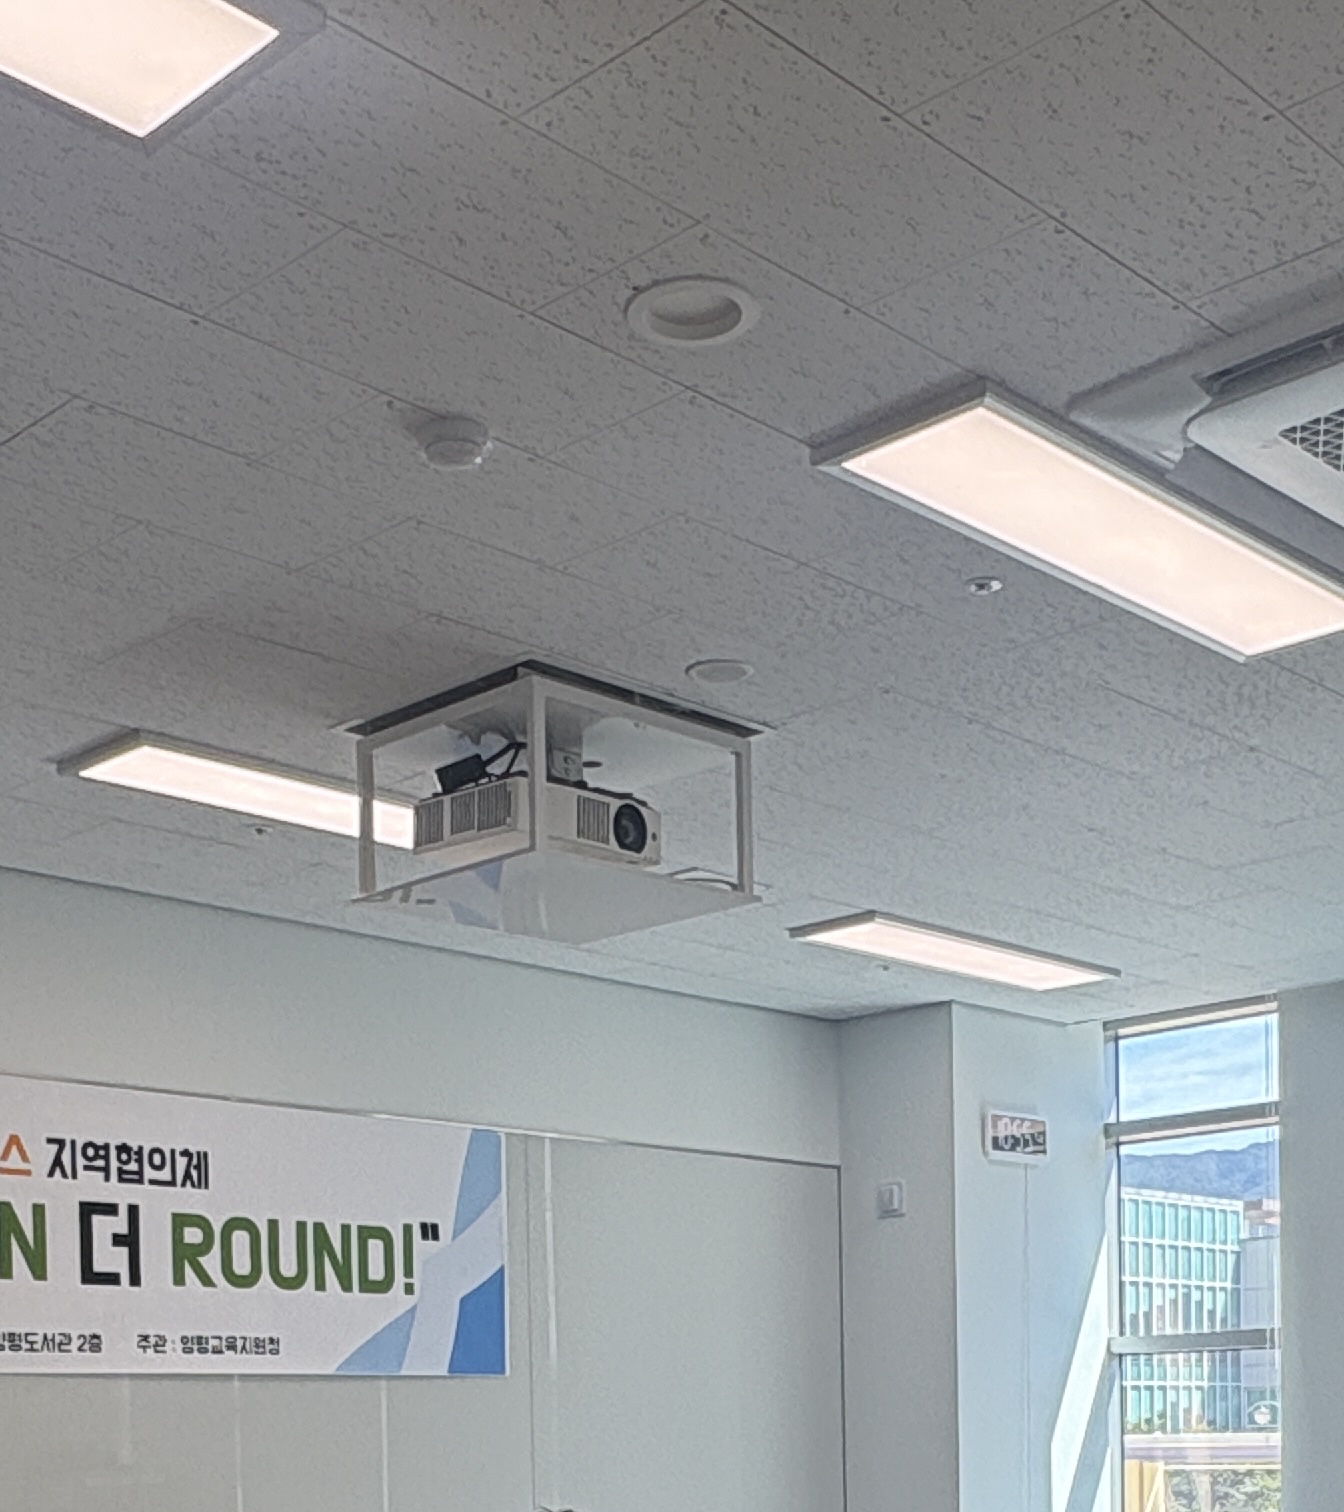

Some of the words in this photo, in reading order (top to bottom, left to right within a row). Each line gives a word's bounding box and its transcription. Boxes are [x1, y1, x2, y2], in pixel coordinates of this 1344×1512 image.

[45, 1137, 210, 1190] 지역협의체
[78, 1200, 142, 1288] 더
[170, 1212, 440, 1296] ROUND!"
[76, 1332, 103, 1353] 2층
[136, 1334, 168, 1354] 주관
[180, 1334, 281, 1356] 양평교육지원청
